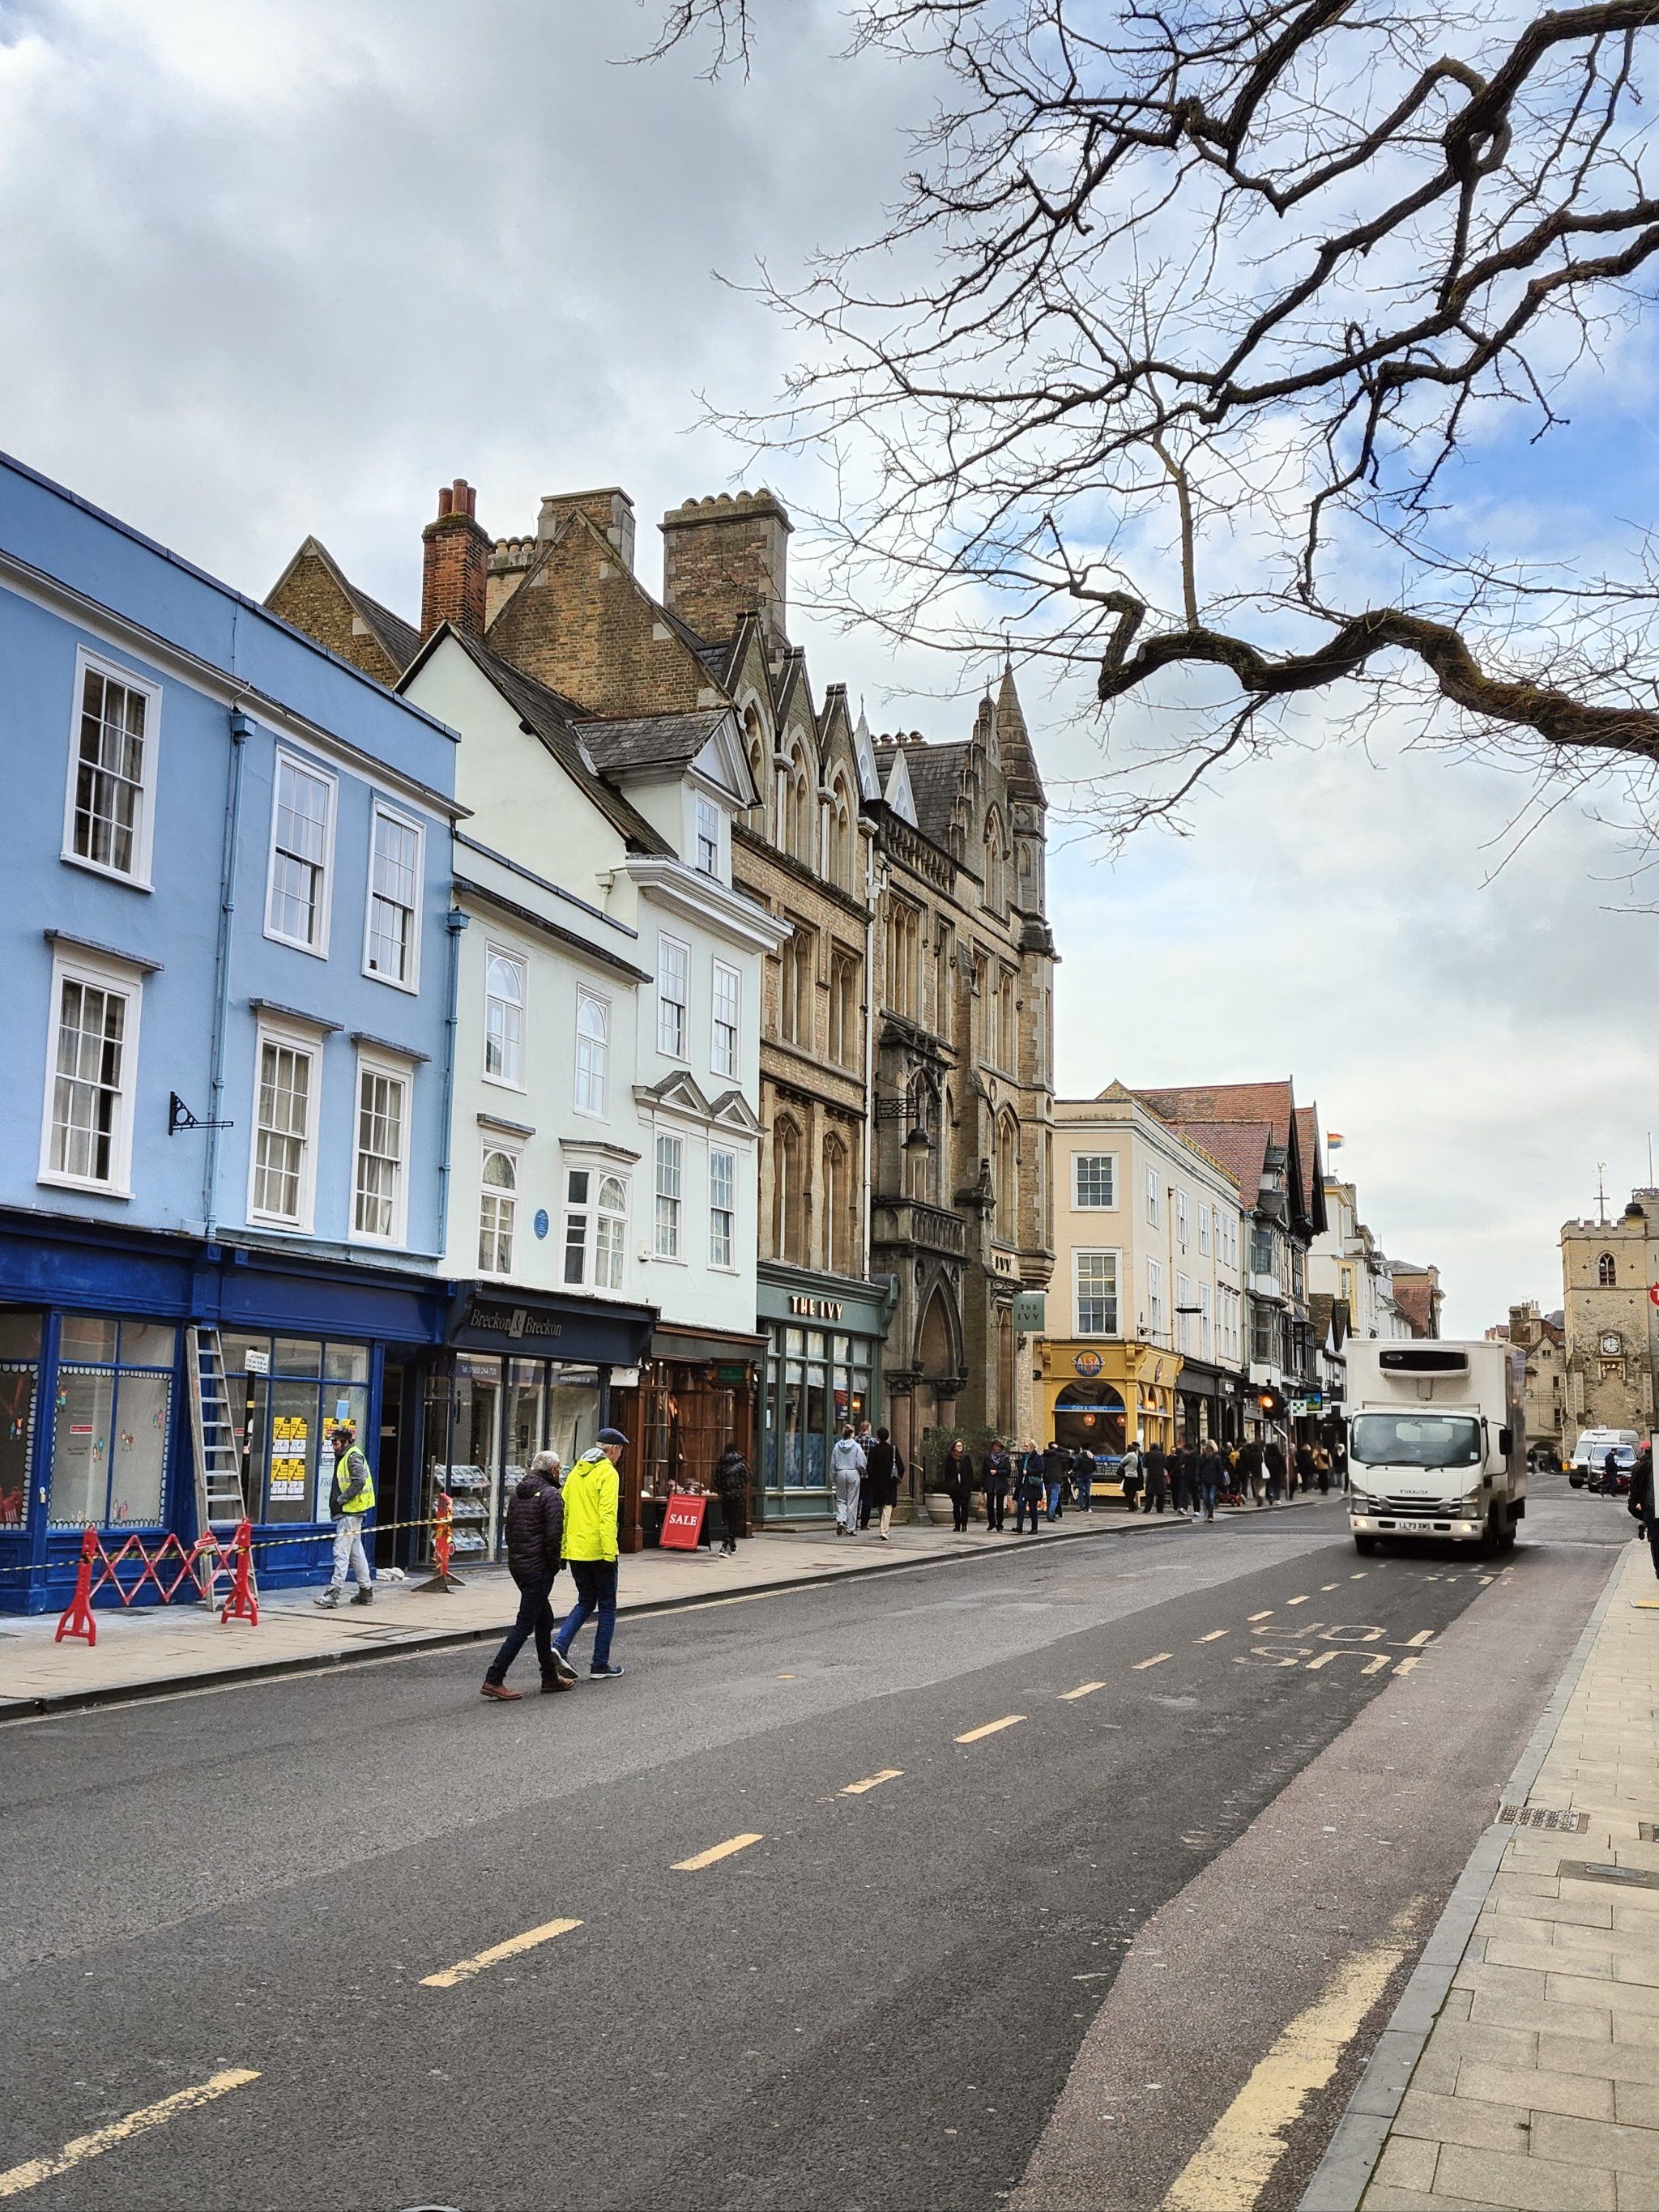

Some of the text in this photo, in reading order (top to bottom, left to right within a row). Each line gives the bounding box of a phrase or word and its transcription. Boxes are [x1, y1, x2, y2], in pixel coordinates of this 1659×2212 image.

[791, 1296, 842, 1319] THE IVY
[471, 1309, 513, 1331] Breckon
[525, 1316, 562, 1336] Breckon
[1071, 1357, 1106, 1366] SALSAS
[668, 1513, 697, 1526] SALE
